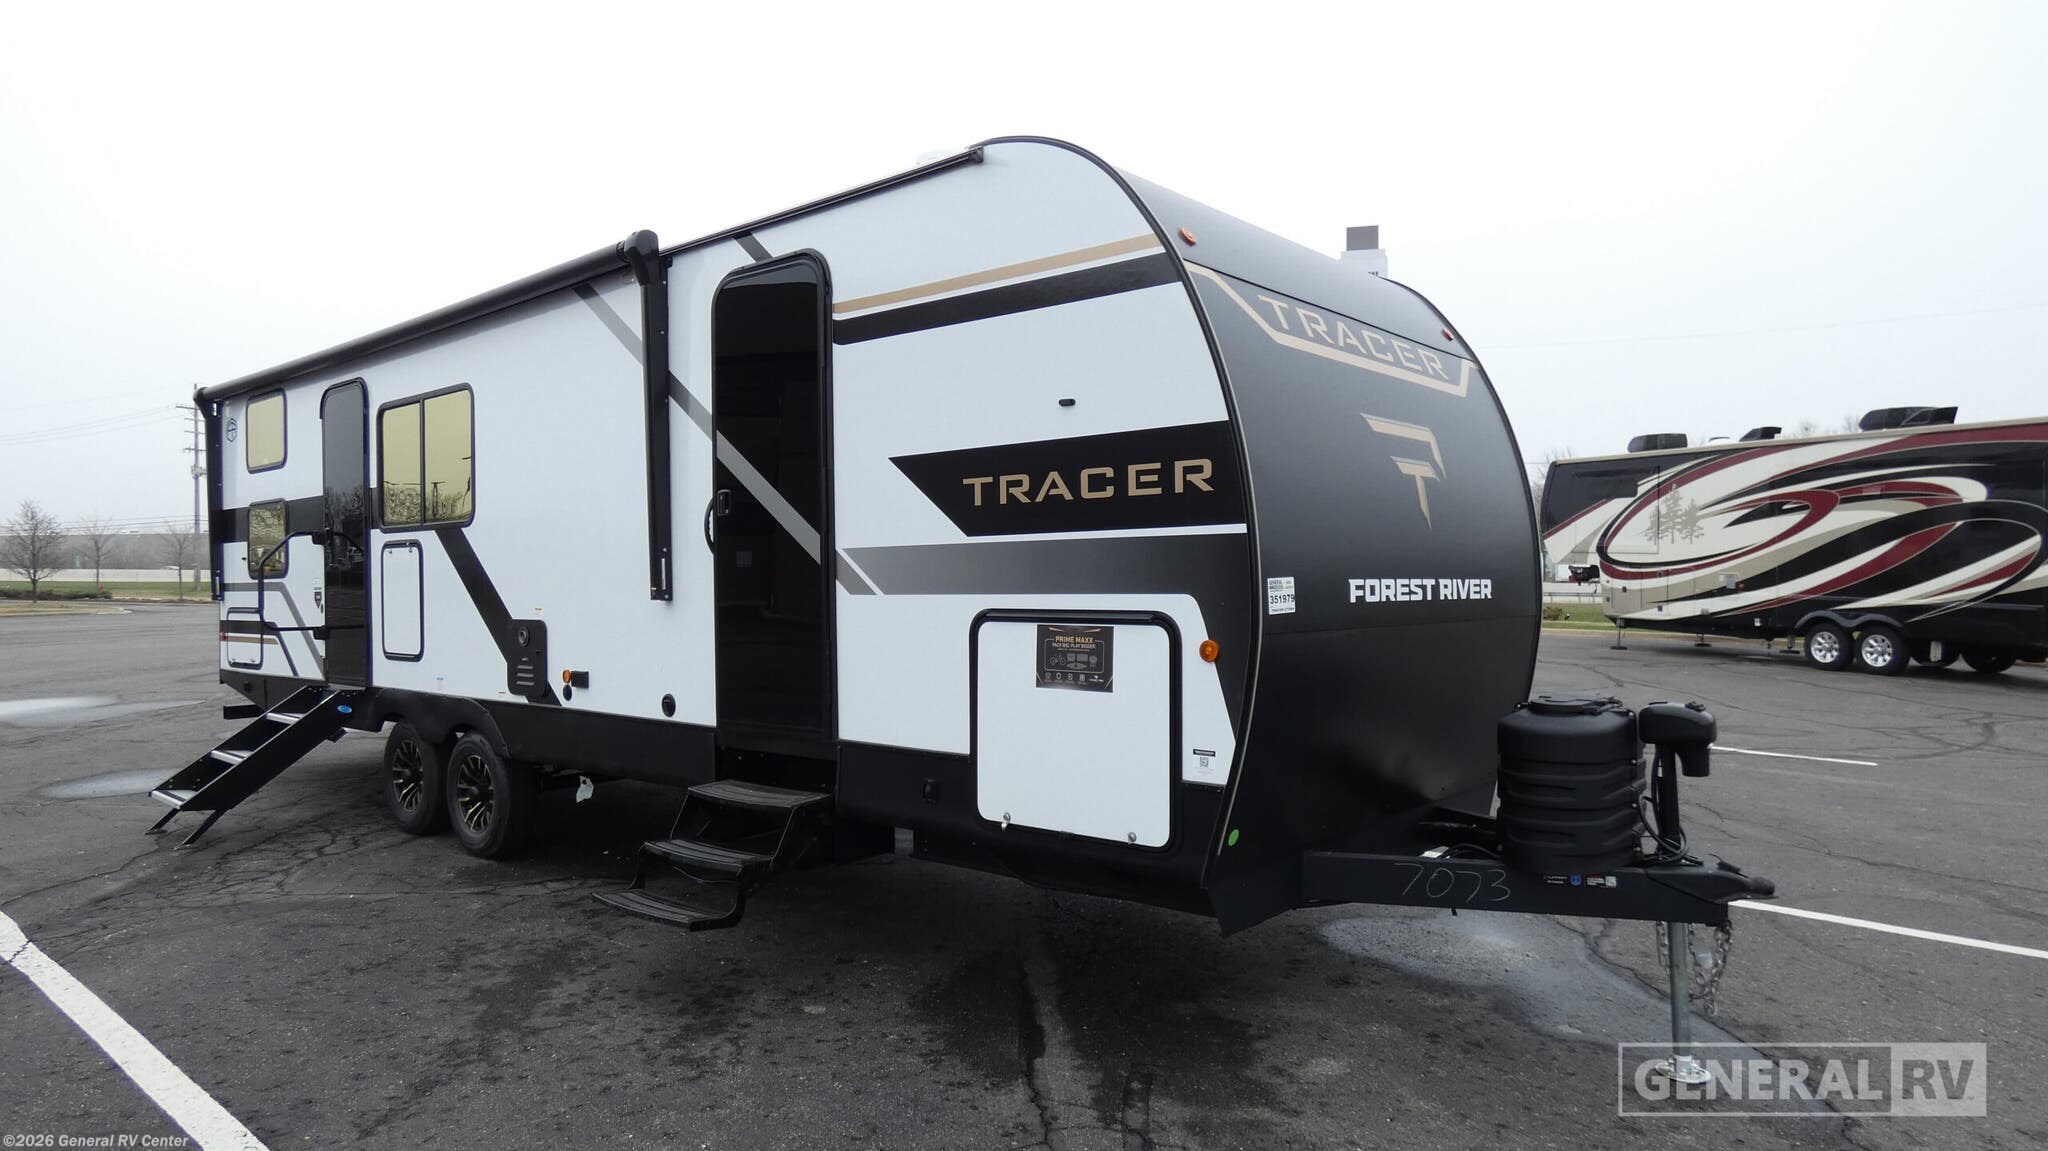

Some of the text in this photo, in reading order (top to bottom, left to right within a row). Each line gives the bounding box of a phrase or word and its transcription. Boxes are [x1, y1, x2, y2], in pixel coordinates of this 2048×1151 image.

[1257, 294, 1449, 380] TRACER
[962, 458, 1215, 506] TRACER
[1270, 594, 1295, 605] 351979
[1348, 578, 1492, 603] FOREST RIVER
[1394, 862, 1511, 903] 7073
